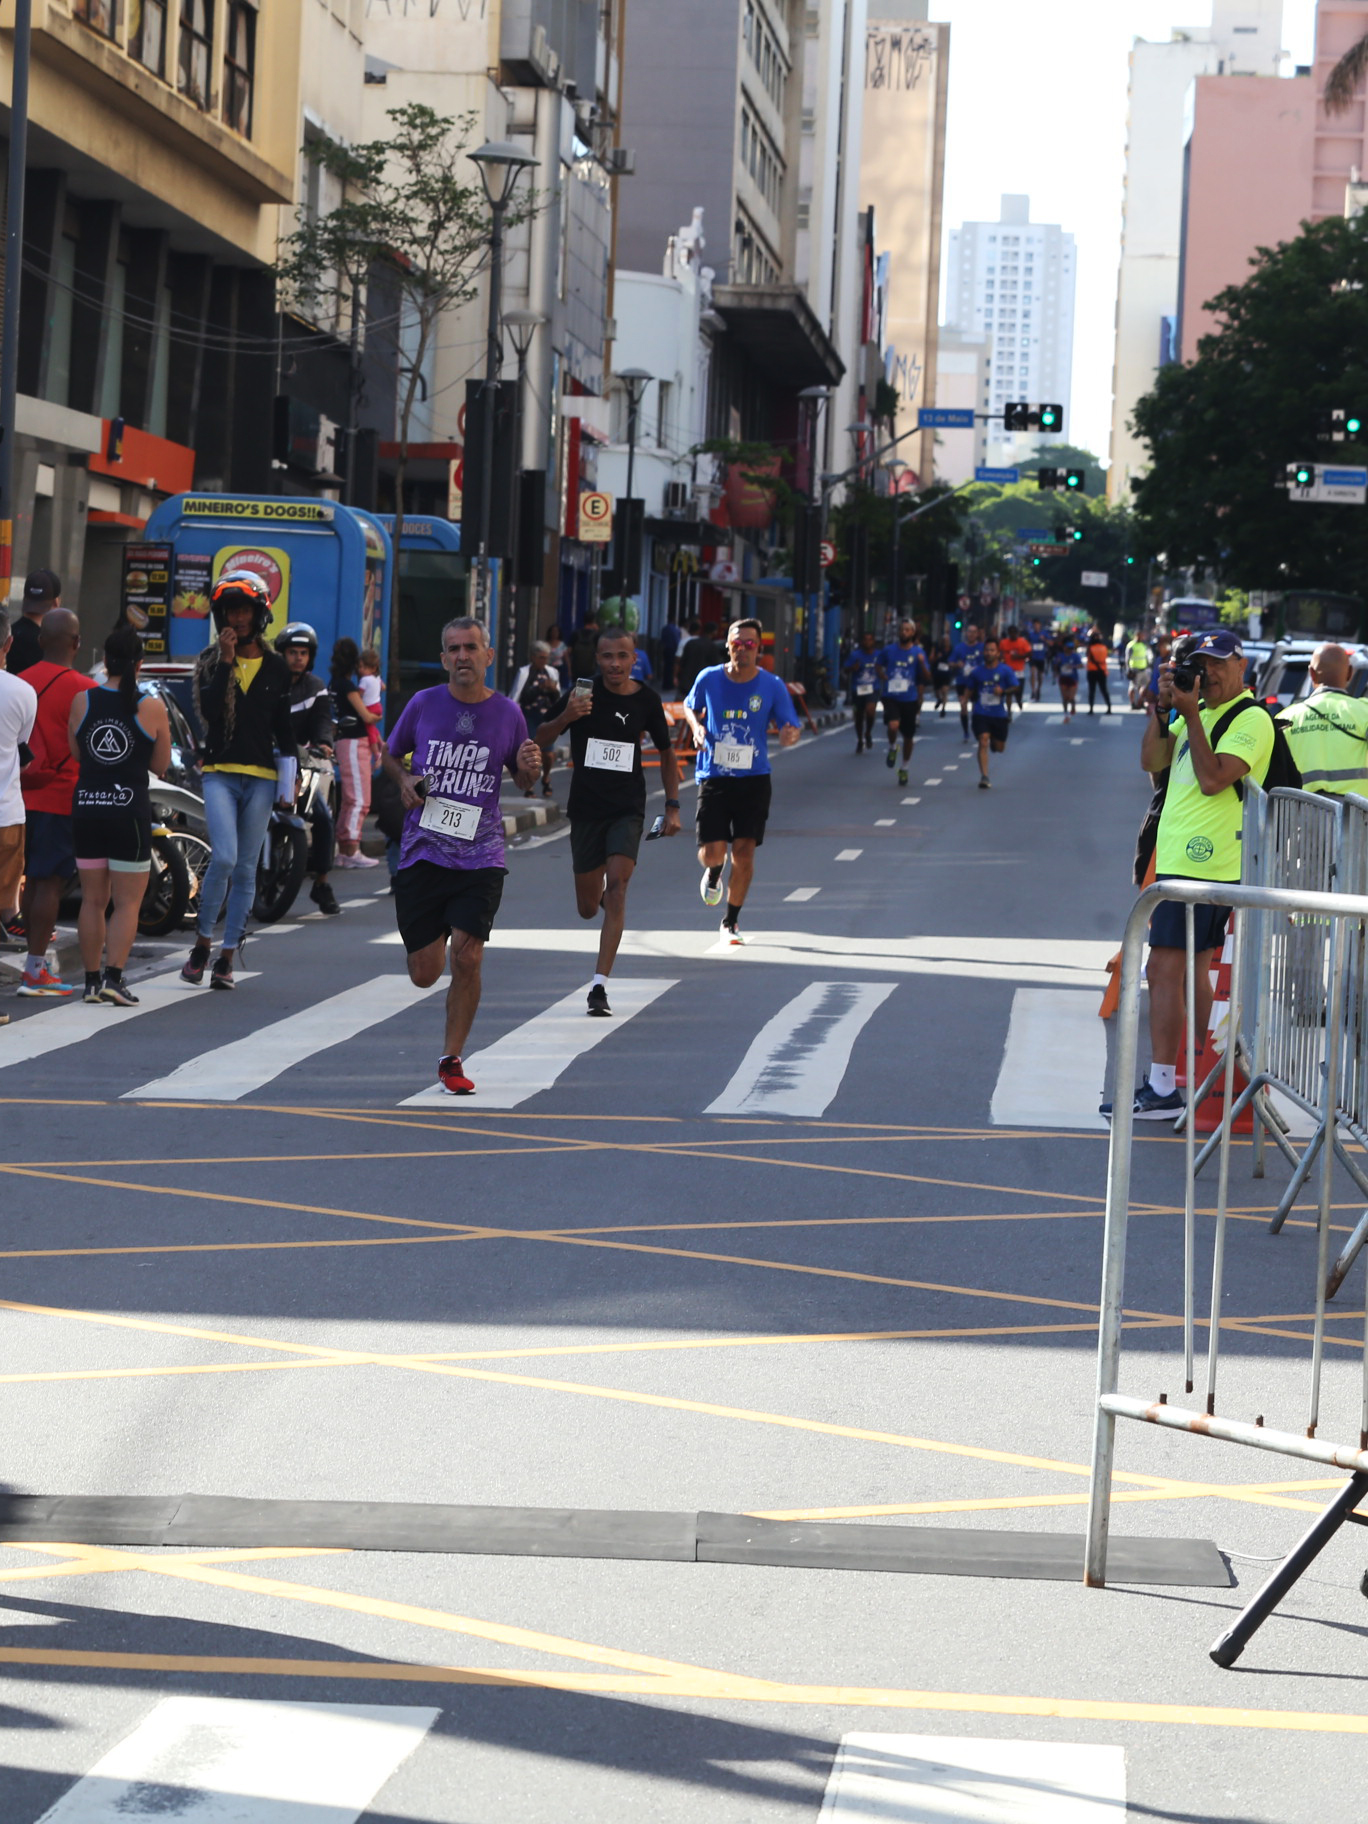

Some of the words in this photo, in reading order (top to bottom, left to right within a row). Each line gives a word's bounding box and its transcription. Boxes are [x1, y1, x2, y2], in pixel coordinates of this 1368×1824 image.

[183, 501, 260, 516] MINEIRO'S
[591, 499, 601, 515] E
[402, 522, 432, 535] DOCES
[426, 740, 490, 772] TIMÃO
[603, 747, 621, 762] 502
[727, 752, 740, 763] 185
[439, 769, 484, 797] RUN
[480, 774, 496, 793] 22
[78, 789, 127, 800] Frutaria
[441, 809, 462, 828] 213
